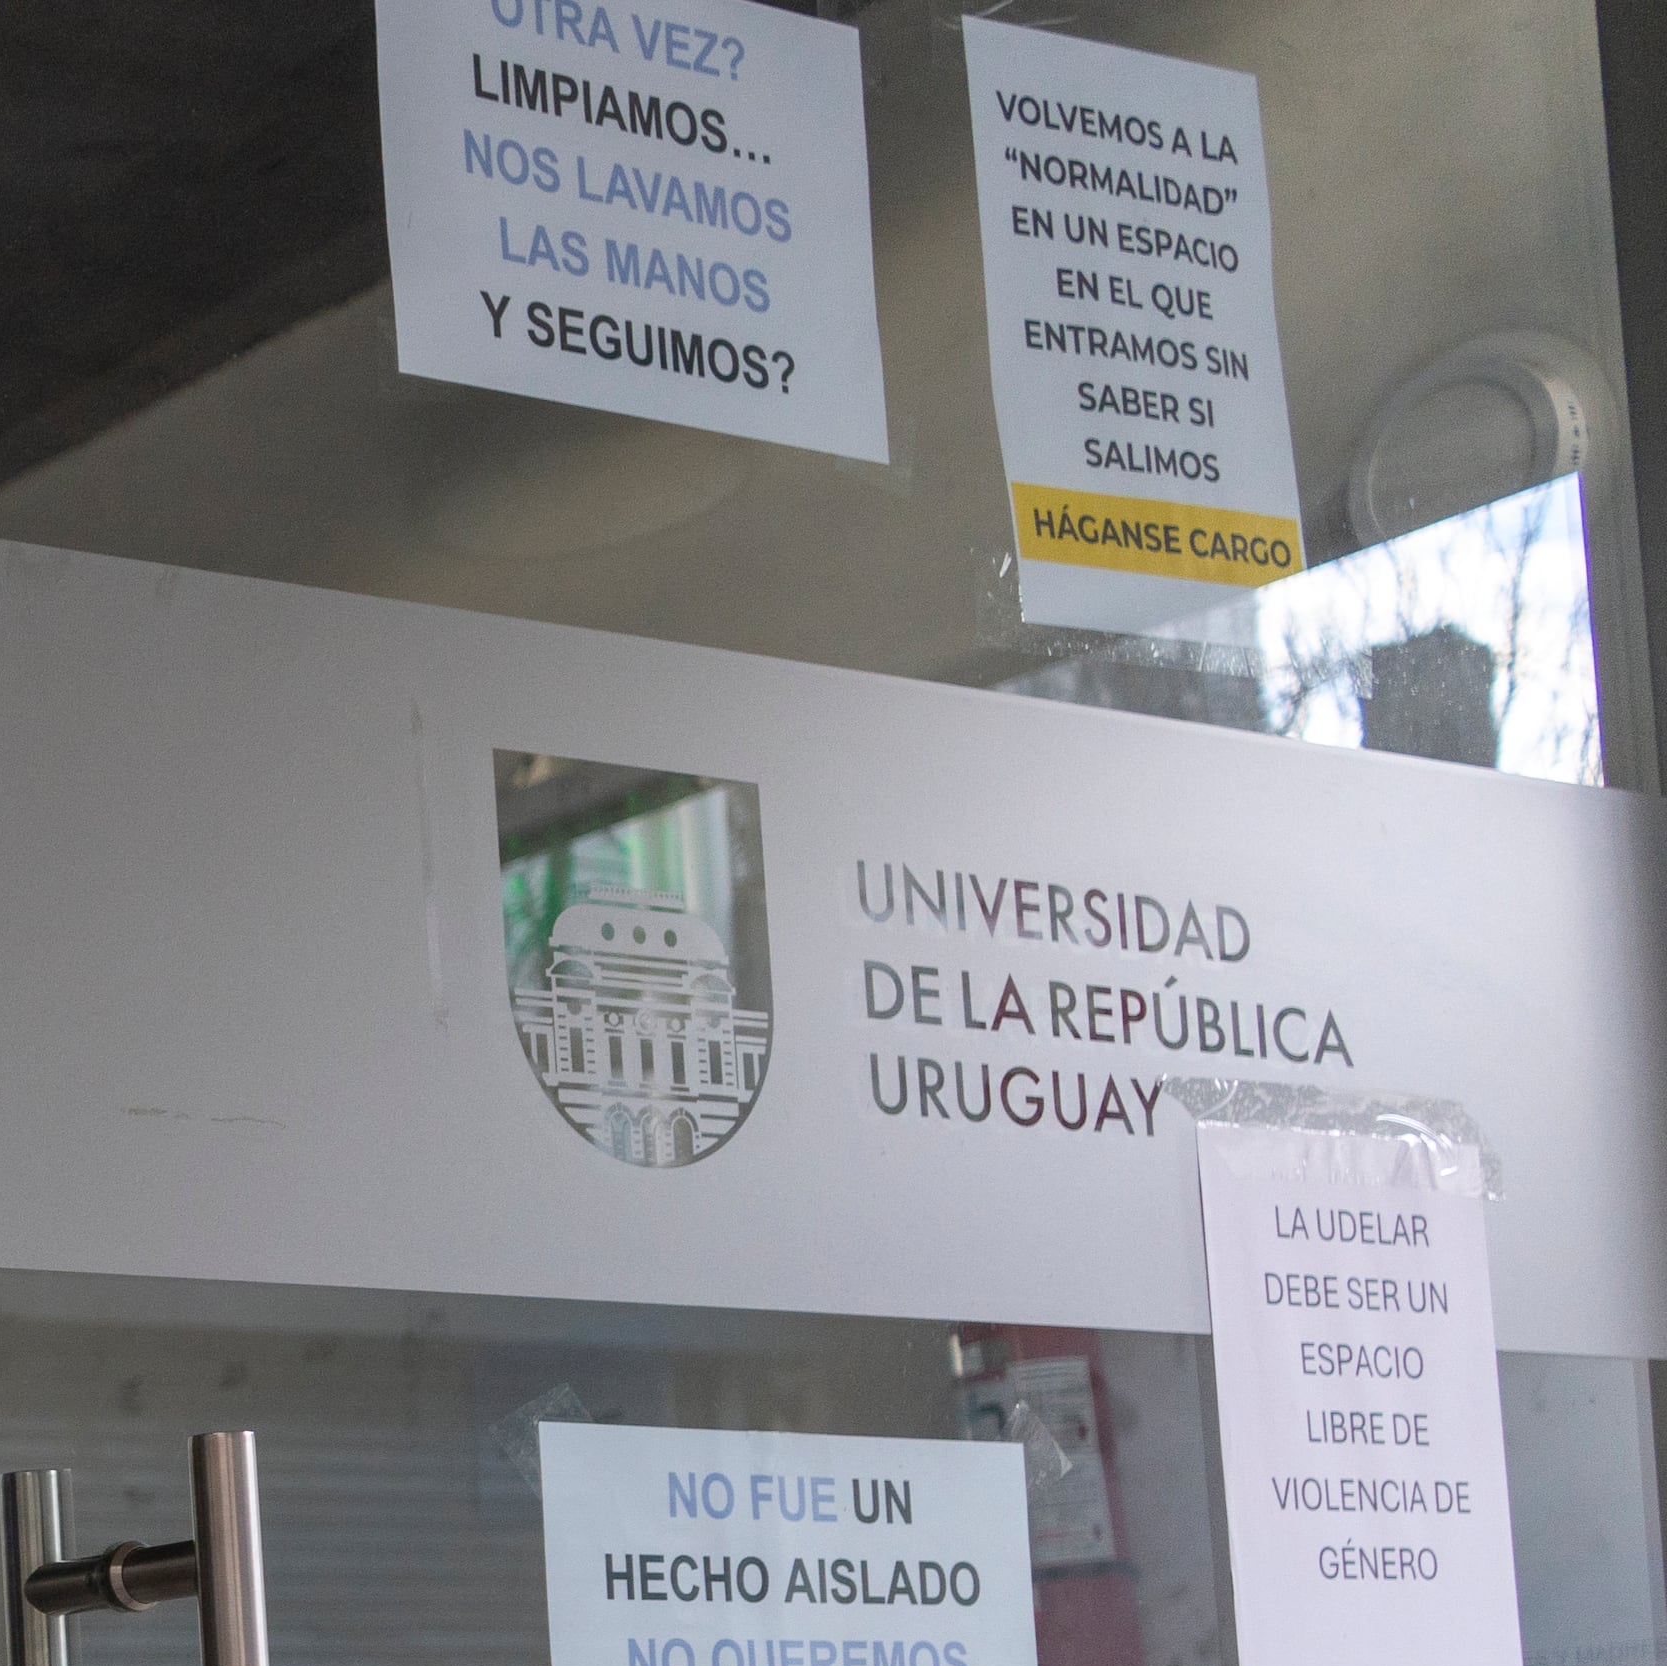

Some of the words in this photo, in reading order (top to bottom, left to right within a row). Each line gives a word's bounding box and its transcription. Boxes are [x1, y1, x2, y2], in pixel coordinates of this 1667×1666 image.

[491, 0, 620, 53] OTRA
[632, 14, 746, 81] VEZ?
[472, 53, 771, 164] LIMPIAMOS...
[995, 90, 1164, 150] VOLVEMOS
[1172, 126, 1192, 156] A
[1201, 131, 1238, 164] LA
[463, 129, 561, 193] NOS
[576, 156, 793, 243] LAVAMOS
[1004, 146, 1238, 216] “NORMALIDAD”
[499, 216, 589, 277] LAS
[605, 238, 771, 313] MANOS
[1012, 205, 1053, 240] EN
[1064, 213, 1109, 248] UN
[1118, 222, 1239, 273] ESPACIO
[1056, 268, 1098, 301] EN
[1109, 277, 1143, 309] EL
[1150, 284, 1213, 320] QUE
[479, 290, 510, 338] Y
[526, 301, 795, 394] SEGUIMOS?
[1024, 318, 1198, 372] ENTRAMOS
[1207, 344, 1249, 381] SIN
[1078, 382, 1180, 424] SABER
[1189, 396, 1214, 428] SI
[1084, 439, 1220, 483] SALIMOS
[1034, 504, 1182, 555] HÁGANSE
[1189, 528, 1292, 569] CARGO
[856, 859, 1251, 964] UNIVERSIDAD
[863, 959, 942, 1026] DE
[962, 970, 1035, 1035] LA
[1049, 975, 1354, 1068] REPÚBLICA
[870, 1051, 1163, 1136] URUGUAY
[1274, 1205, 1309, 1241] LA
[1316, 1208, 1429, 1248] UDELAR
[1264, 1272, 1339, 1310] DEBE
[1347, 1277, 1399, 1312] SER
[1408, 1280, 1449, 1315] UN
[1300, 1342, 1424, 1380] ESPACIO
[1306, 1409, 1385, 1445] LIBRE
[1393, 1412, 1430, 1446] DE
[668, 1471, 735, 1519] NO
[750, 1474, 838, 1523] FUE
[852, 1478, 913, 1525] UN
[1271, 1476, 1427, 1513] VIOLENCIA
[1435, 1481, 1471, 1514] DE
[605, 1552, 769, 1603] HECHO
[784, 1558, 981, 1606] AISLADO
[1319, 1538, 1438, 1581] GÉNERO
